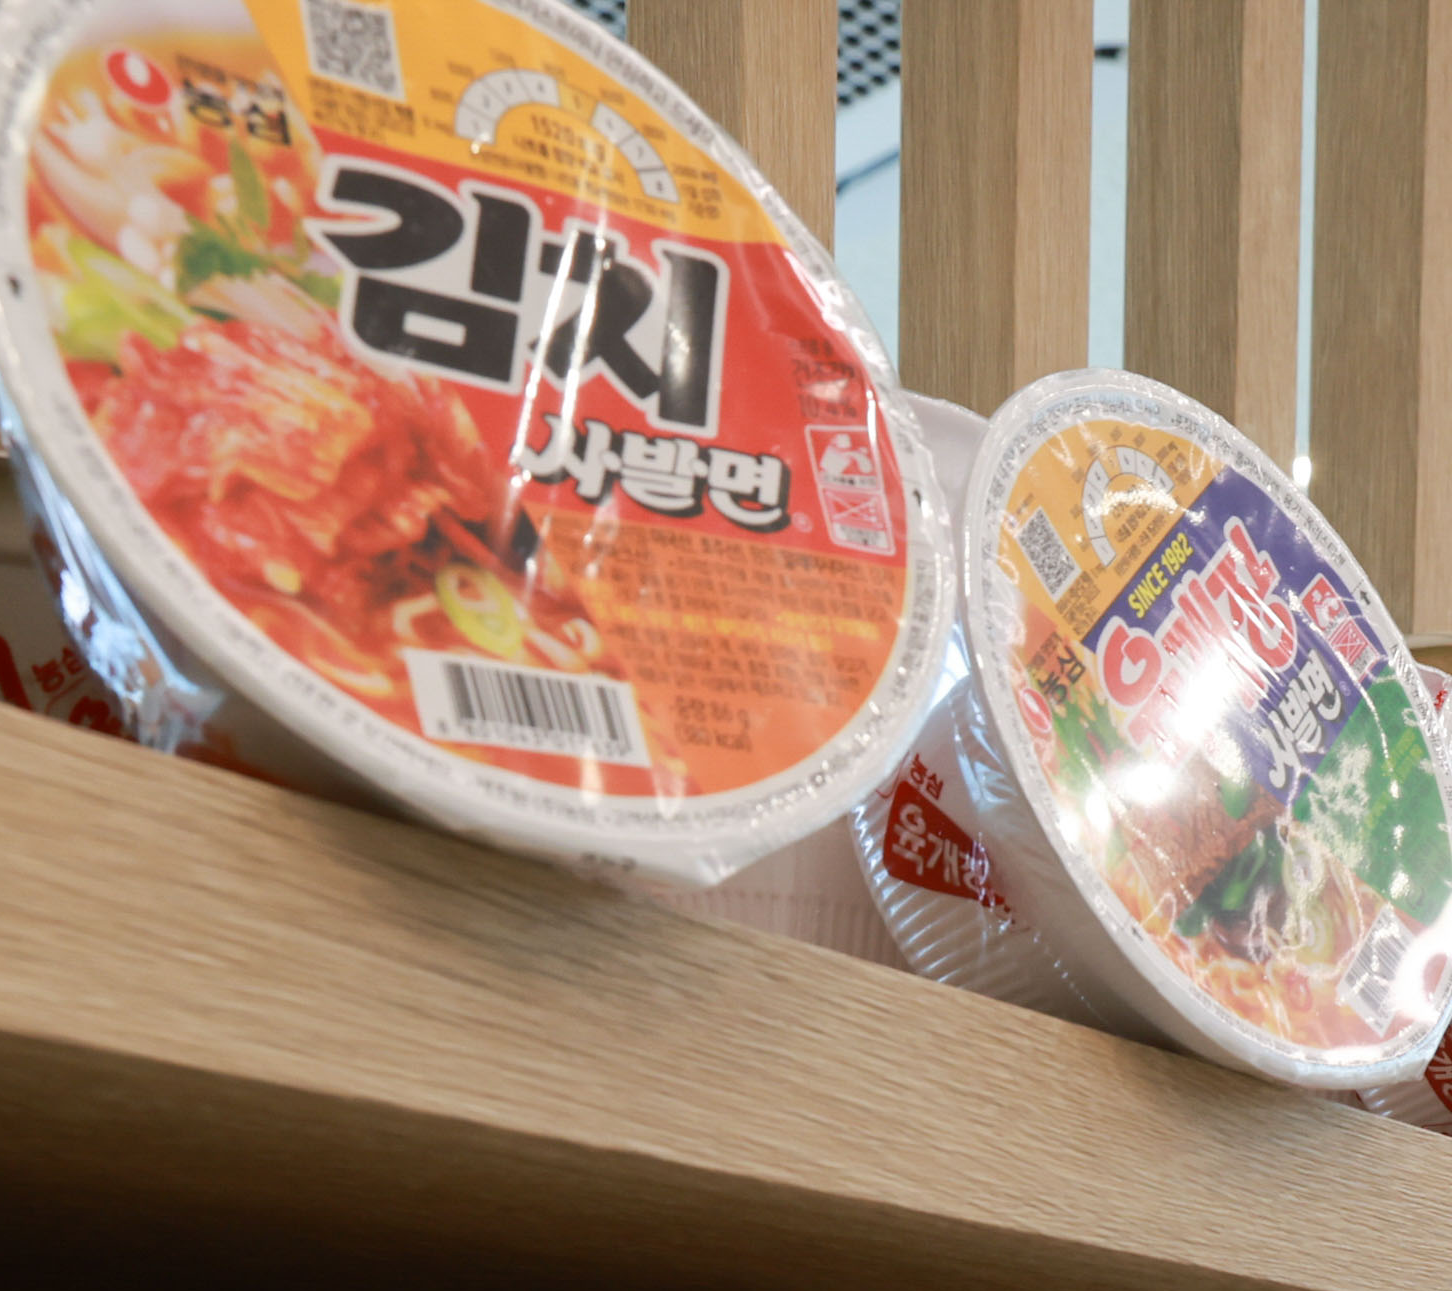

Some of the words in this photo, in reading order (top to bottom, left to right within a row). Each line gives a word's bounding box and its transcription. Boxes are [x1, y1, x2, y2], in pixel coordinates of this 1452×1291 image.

[316, 165, 726, 430] 김치
[511, 414, 791, 533] 사발면
[1128, 569, 1165, 620] SINCE
[1160, 532, 1195, 579] 1982
